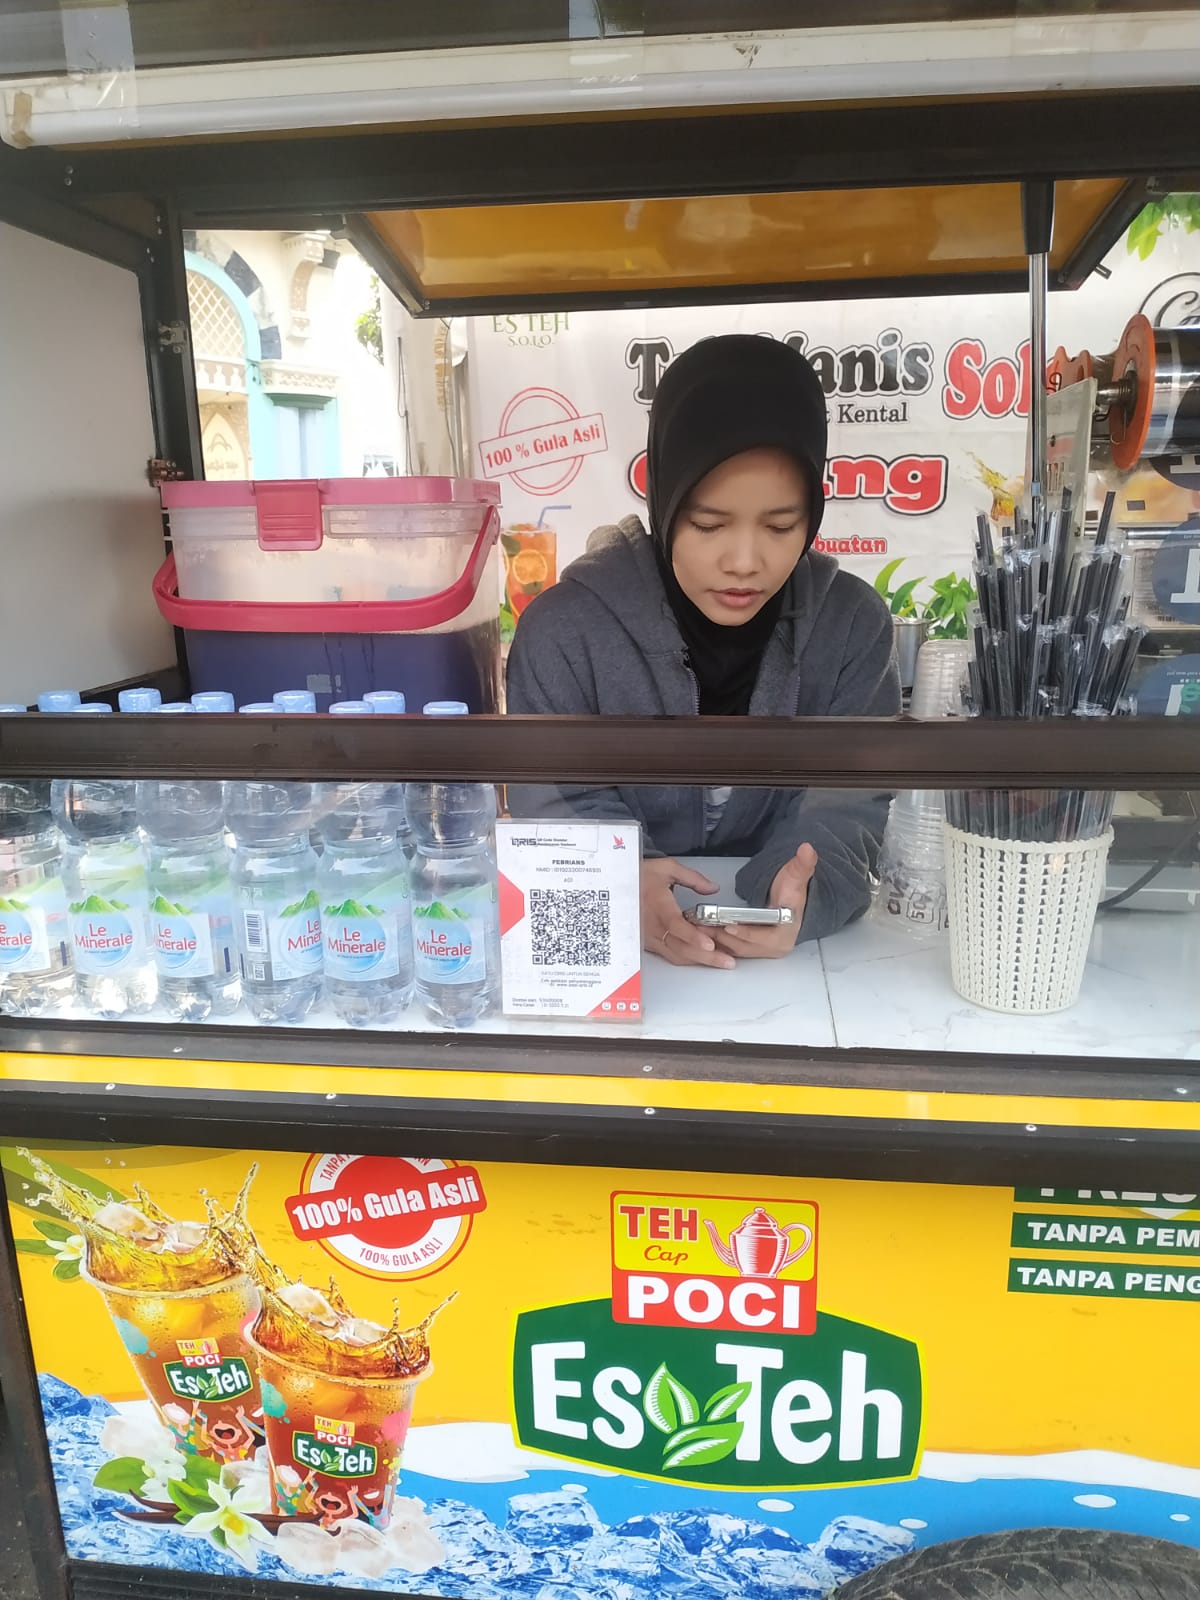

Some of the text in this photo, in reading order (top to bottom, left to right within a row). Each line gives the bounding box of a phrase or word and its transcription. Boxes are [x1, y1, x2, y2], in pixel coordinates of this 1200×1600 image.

[785, 331, 932, 394] anis
[837, 402, 908, 424] Kental
[486, 447, 513, 468] 100
[533, 433, 569, 455] Gula
[573, 423, 601, 445] Asli
[89, 923, 107, 937] Le
[158, 923, 171, 938] Le
[307, 920, 320, 933] Le
[343, 927, 361, 942] Le
[431, 930, 447, 944] Le
[75, 932, 133, 950] Minerale
[328, 936, 386, 954] Minerale
[417, 938, 472, 956] Minerale
[292, 1175, 480, 1231] 100% Gula Asli
[618, 1205, 699, 1242] TEH
[1027, 1221, 1200, 1248] TANPA PEM
[359, 1236, 444, 1267] 100% GULA ASLI
[643, 1244, 689, 1266] Cap
[1016, 1266, 1115, 1290] TANPA
[627, 1275, 801, 1329] POCI
[184, 1354, 220, 1366] POCI
[170, 1363, 249, 1395] Es Teh
[530, 1340, 903, 1465] Es Teh
[317, 1431, 352, 1446] POCI
[296, 1439, 374, 1473] Es Teh
